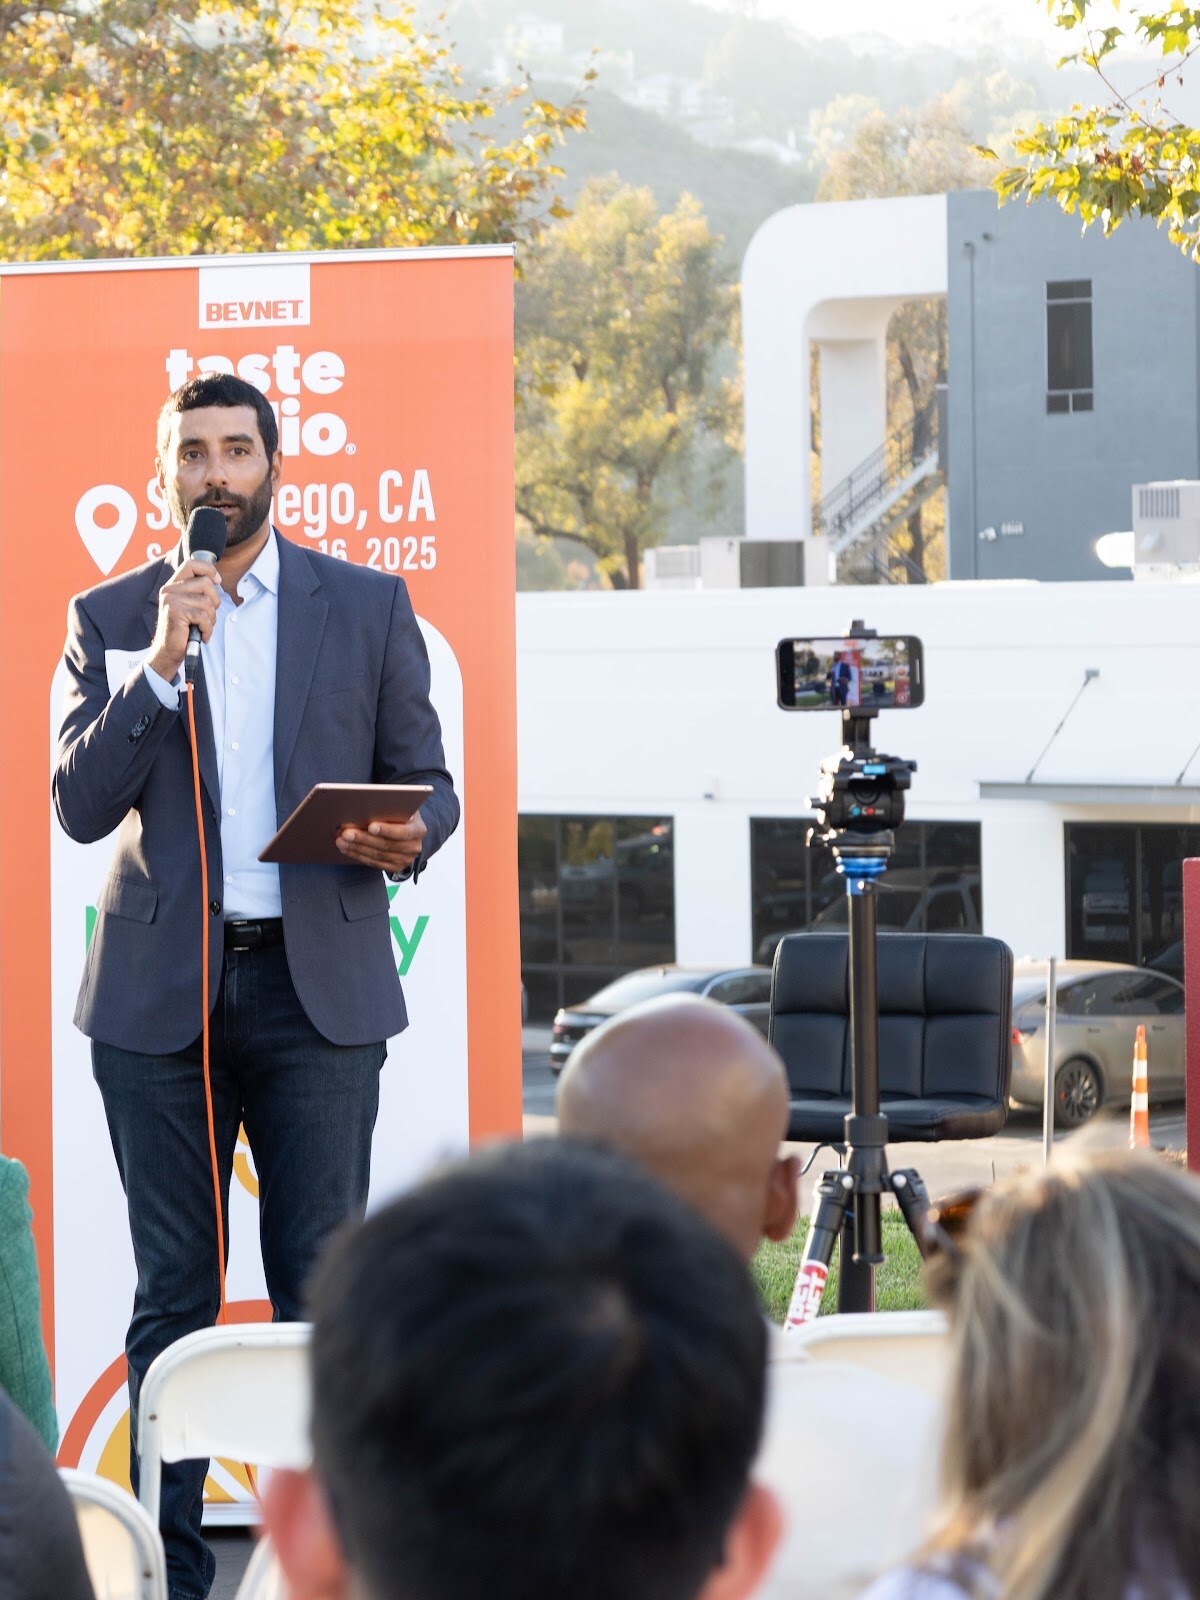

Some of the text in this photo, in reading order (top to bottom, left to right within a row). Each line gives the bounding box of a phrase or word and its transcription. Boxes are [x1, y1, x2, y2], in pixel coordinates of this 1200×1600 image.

[205, 299, 303, 323] BEVNET
[378, 468, 437, 524] CA
[366, 535, 437, 572] 2025
